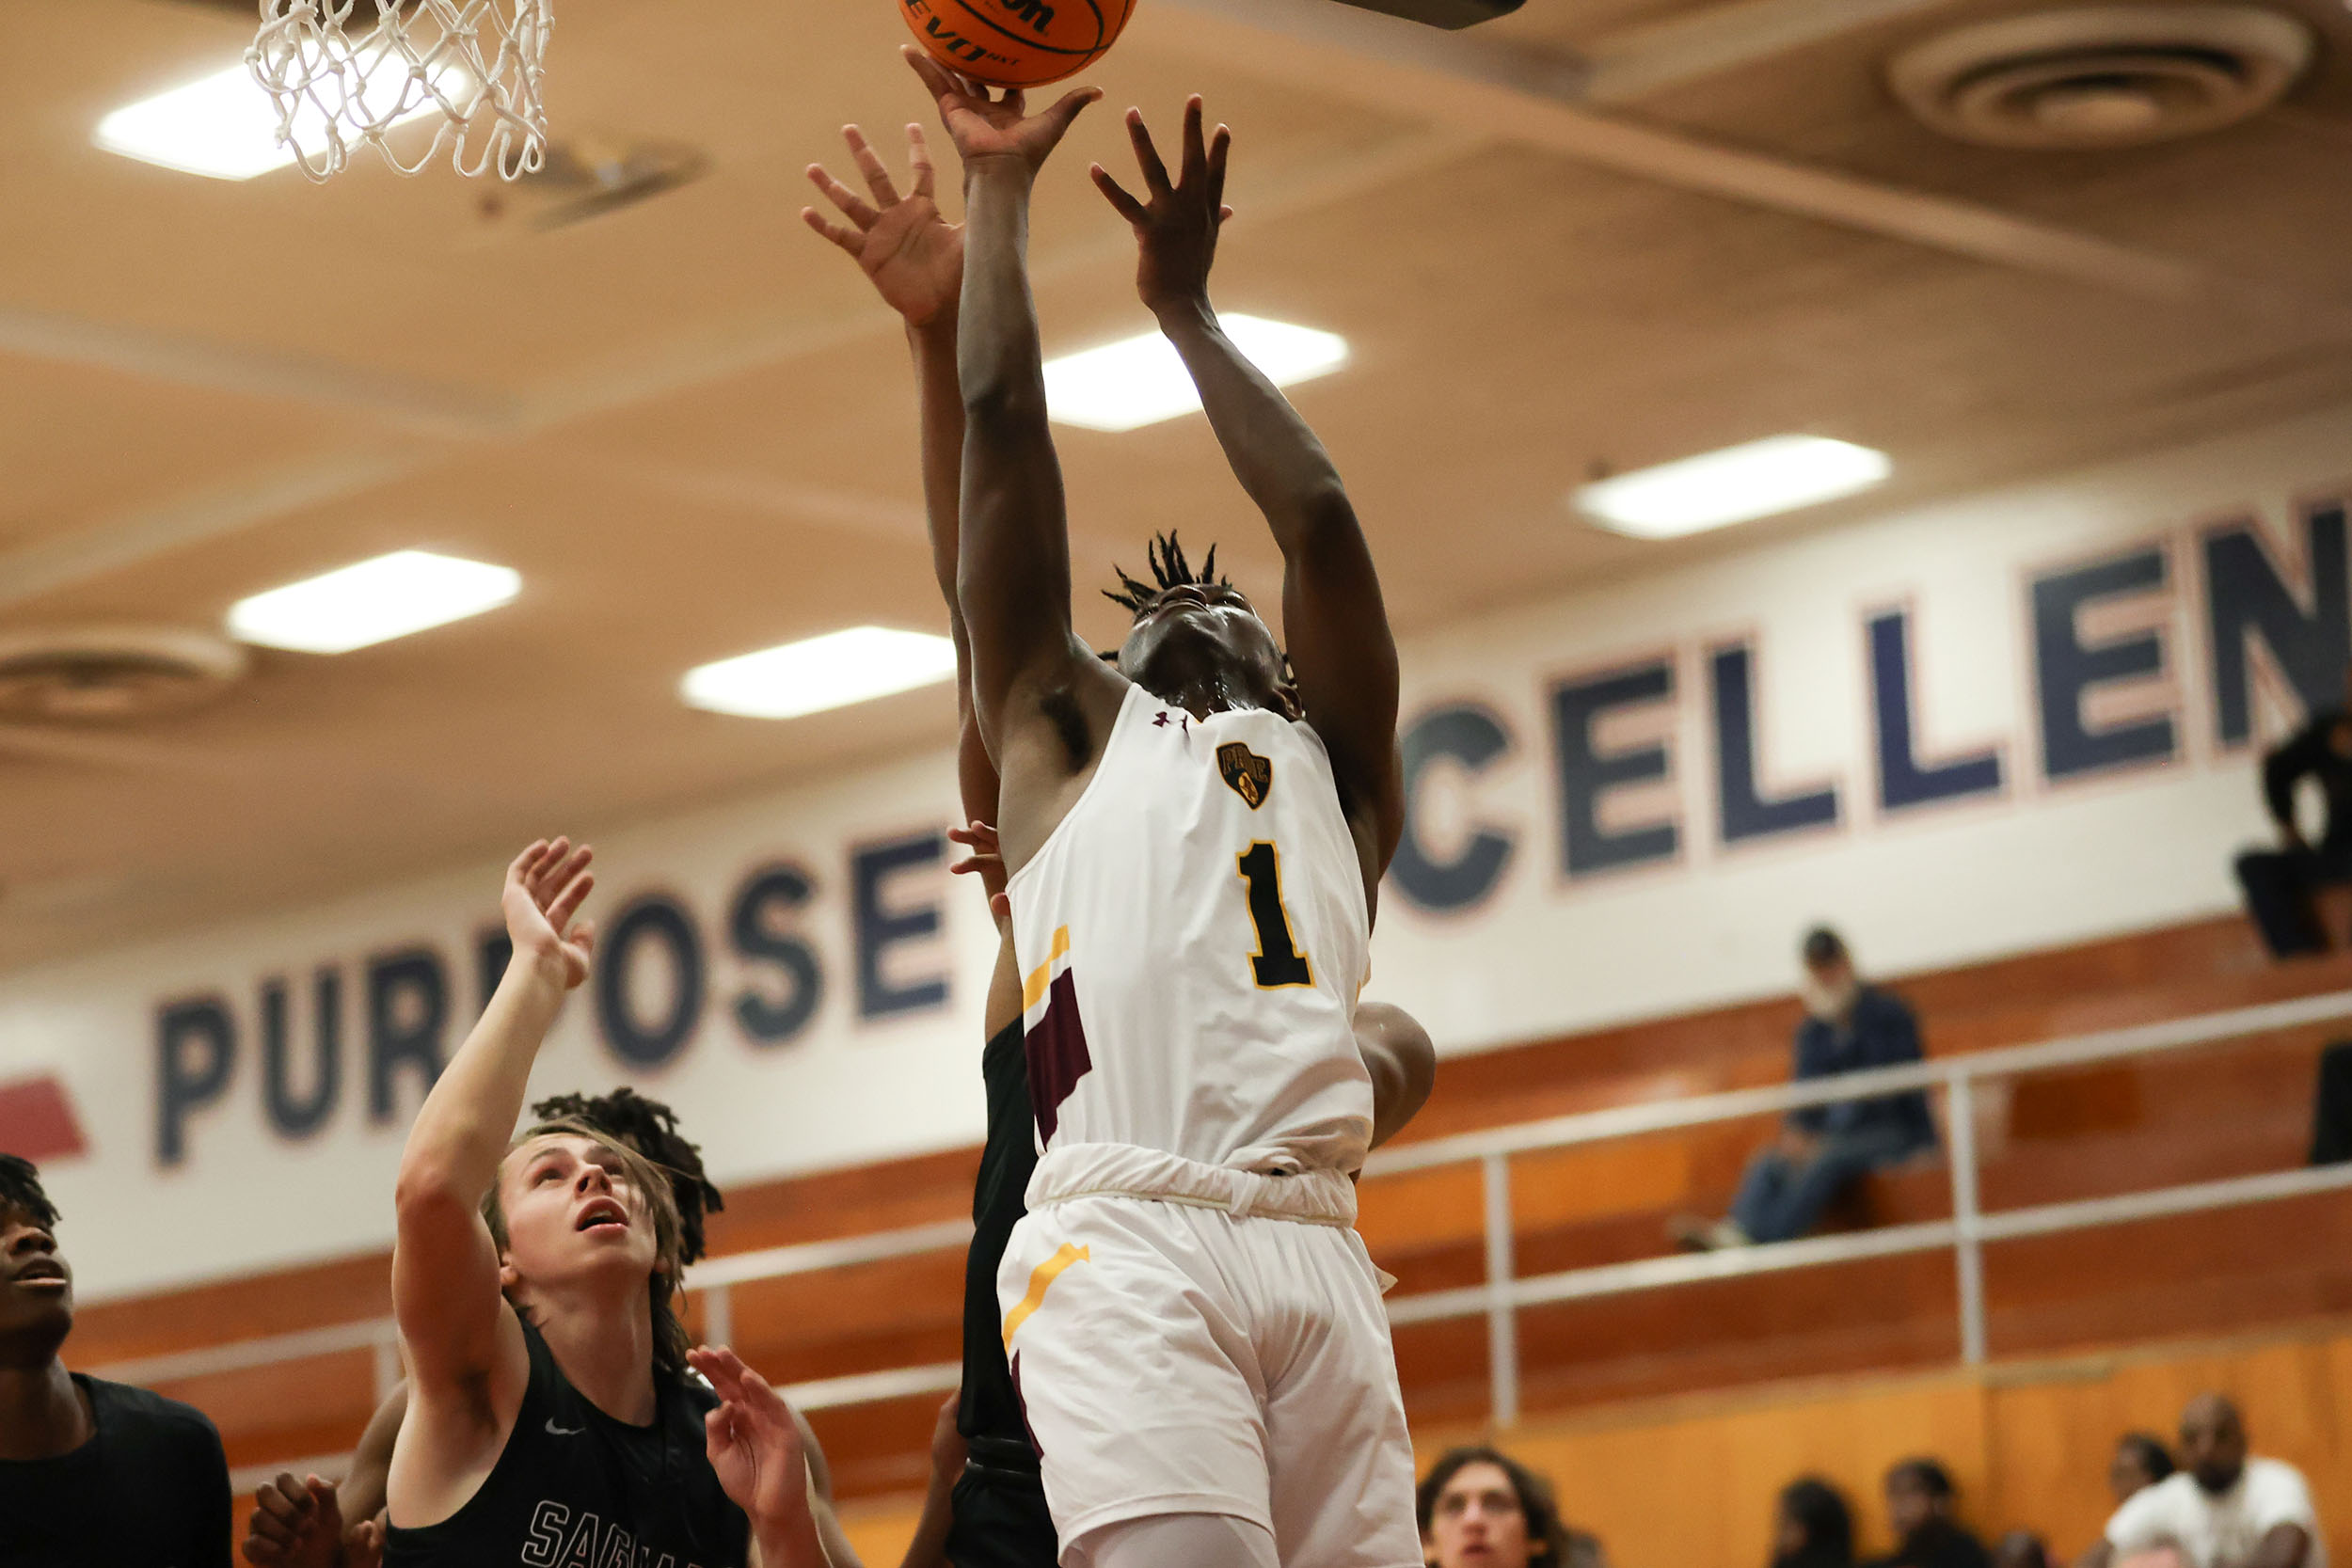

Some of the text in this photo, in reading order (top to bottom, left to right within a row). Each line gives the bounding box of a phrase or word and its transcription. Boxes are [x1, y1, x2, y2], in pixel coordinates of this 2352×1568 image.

[904, 0, 987, 61] EVO
[1235, 838, 1317, 991] 1
[151, 832, 952, 1166] PUROSE
